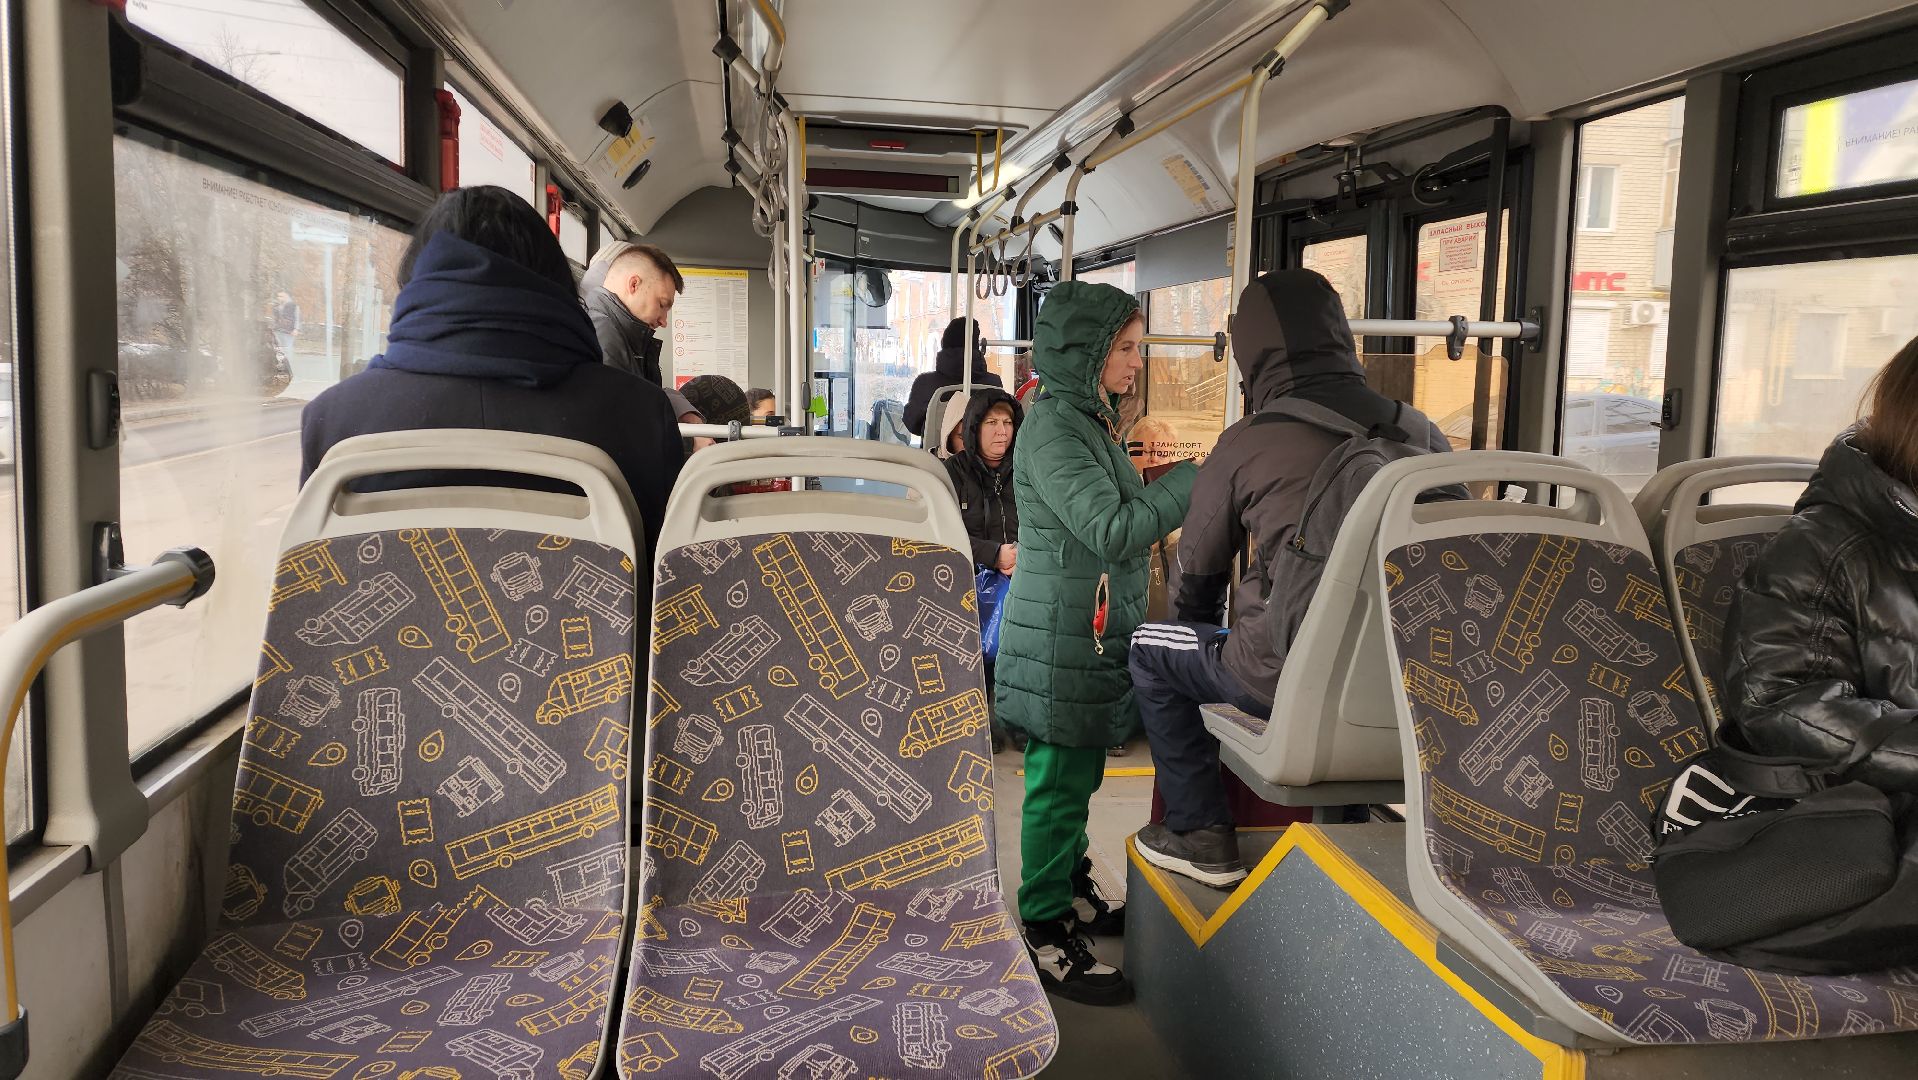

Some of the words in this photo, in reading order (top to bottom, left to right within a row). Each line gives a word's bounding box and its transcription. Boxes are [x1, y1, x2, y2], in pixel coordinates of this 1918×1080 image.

[1845, 128, 1901, 148] ВНИМАНИЕ!
[1903, 126, 1918, 136] РА
[1150, 441, 1202, 449] ТРАНСПОРТ
